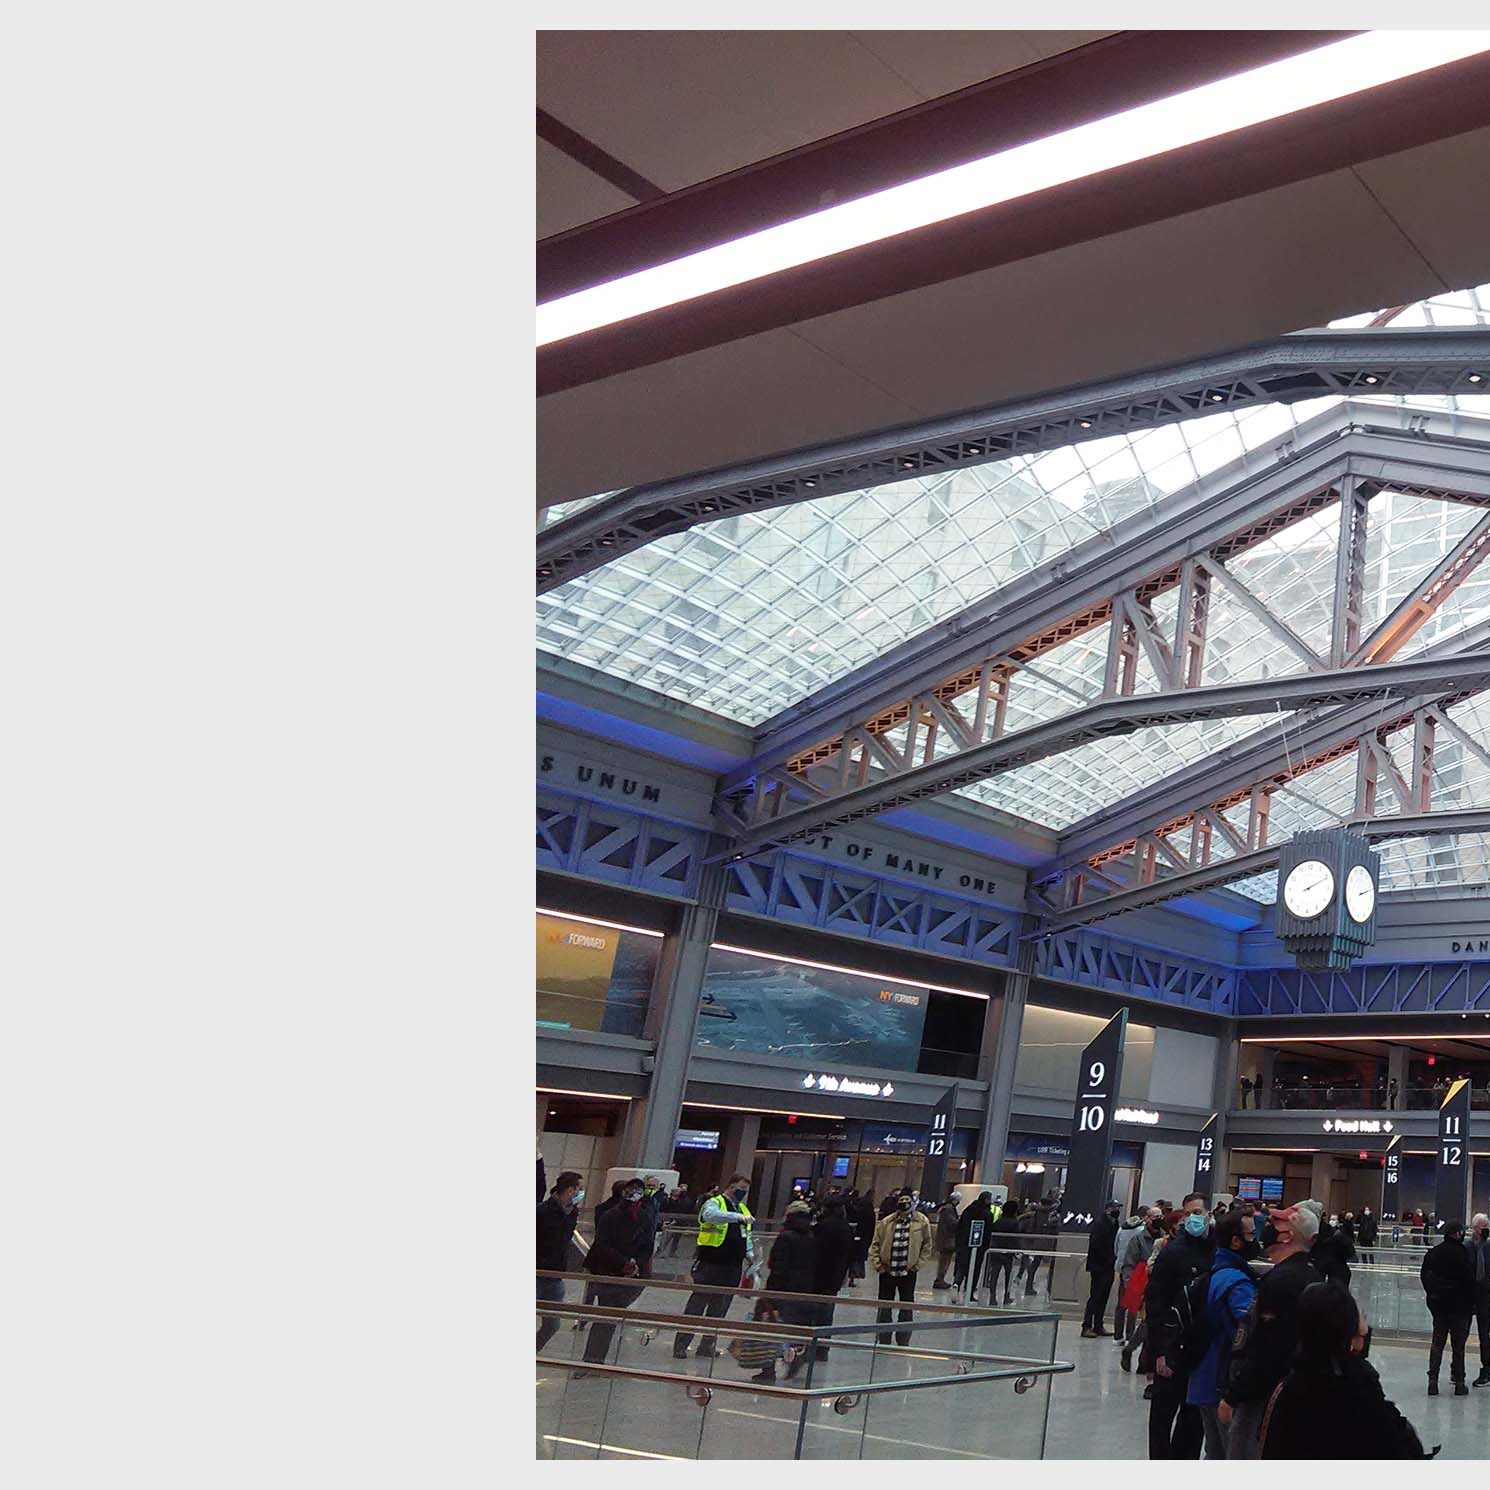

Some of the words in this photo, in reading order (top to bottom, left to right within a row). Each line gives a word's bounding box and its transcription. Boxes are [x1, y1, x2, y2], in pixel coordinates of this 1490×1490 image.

[578, 766, 661, 802] UNUM
[847, 844, 873, 861] OF
[886, 854, 944, 880] MANY
[960, 875, 997, 894] ONE
[880, 990, 894, 1001] NY
[1089, 1062, 1105, 1087] 9
[932, 1113, 946, 1130] 11
[1079, 1105, 1105, 1132] 10
[1445, 1116, 1460, 1135] 11
[928, 1139, 945, 1156] 12
[1200, 1138, 1213, 1151] 13
[1388, 1155, 1399, 1167] 15
[1443, 1146, 1461, 1165] 12
[1198, 1158, 1211, 1172] 14
[1387, 1172, 1398, 1184] 16
